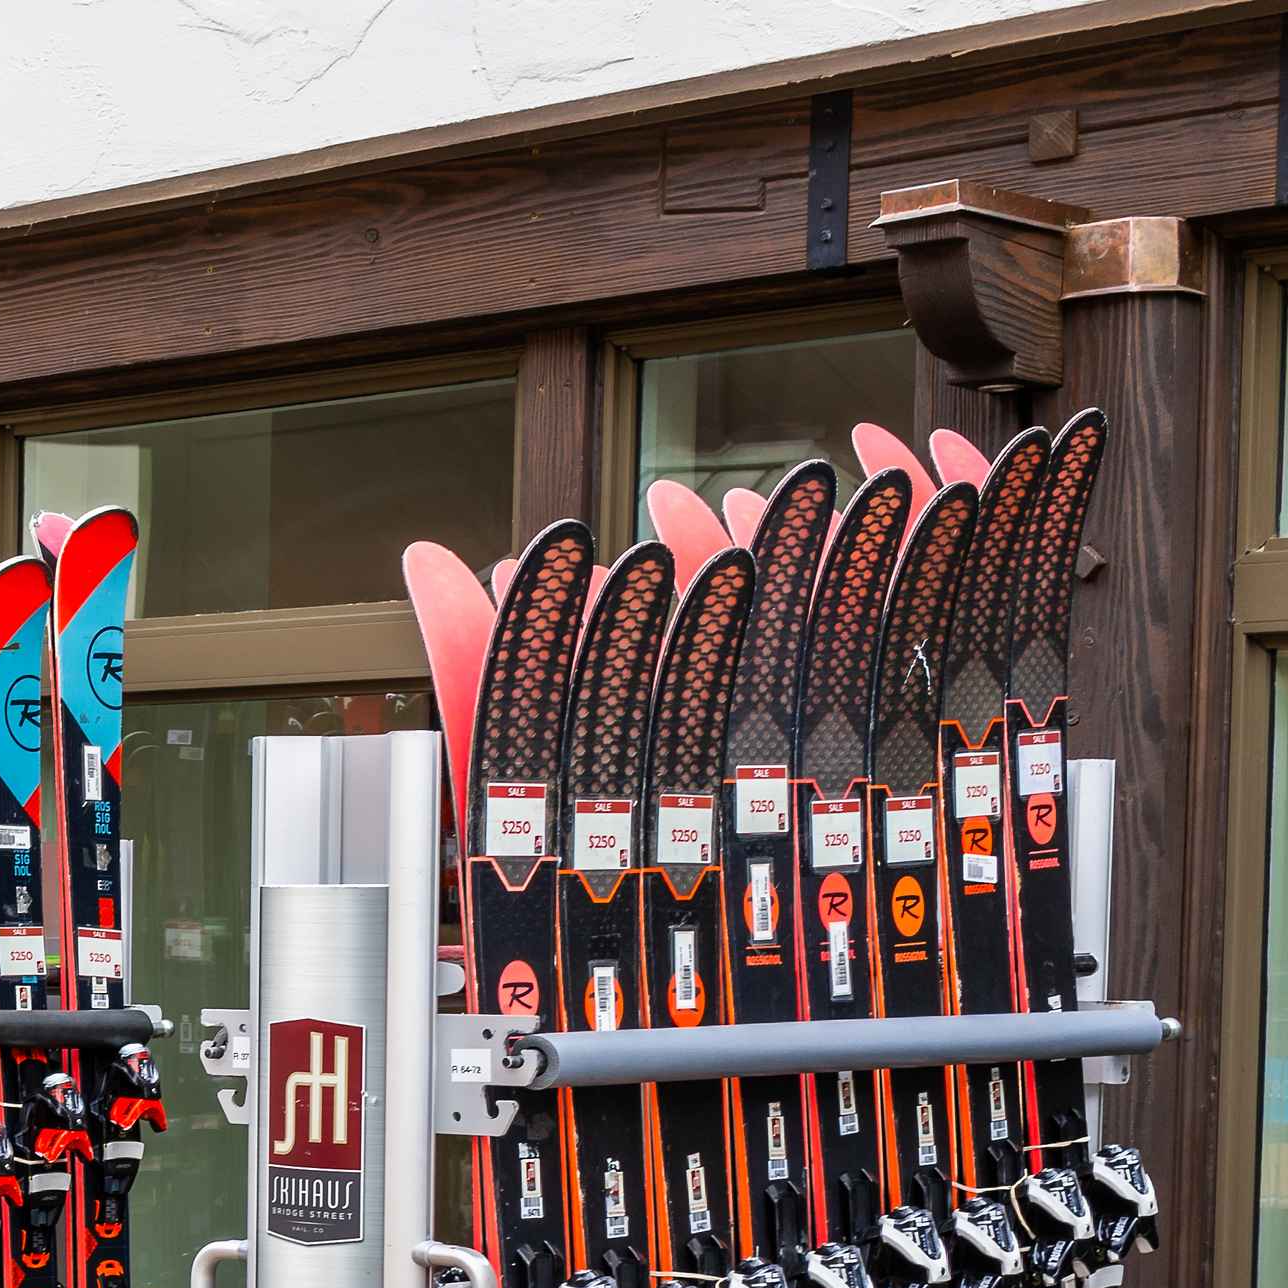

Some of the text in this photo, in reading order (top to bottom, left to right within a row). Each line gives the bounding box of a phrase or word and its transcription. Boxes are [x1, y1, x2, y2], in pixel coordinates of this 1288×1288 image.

[1032, 735, 1046, 744] SALE
[969, 757, 985, 765] SALE
[753, 769, 769, 778] SALE
[1030, 763, 1052, 776] $250
[507, 787, 527, 797] SALE
[966, 785, 988, 798] $250
[94, 800, 112, 812] ROS
[594, 803, 613, 813] SALE
[677, 798, 695, 807] SALE
[749, 799, 775, 813] $250
[828, 804, 844, 812] SALE
[901, 800, 917, 809] SALE
[95, 812, 111, 823] SIG
[1029, 804, 1053, 828] R
[94, 823, 112, 835] NOL
[501, 820, 531, 835] $250
[588, 835, 617, 849] $250
[671, 829, 698, 844] $250
[823, 833, 849, 847] $250
[898, 829, 922, 843] $250
[964, 828, 989, 852] R
[14, 854, 31, 865] SIG
[14, 865, 32, 877] NOL
[822, 891, 849, 917] R
[895, 894, 921, 919] R
[10, 951, 33, 961] $250
[88, 952, 112, 964] $250
[502, 981, 534, 1010] R
[271, 1175, 353, 1210] SKIHAUS
[271, 1206, 353, 1221] BRIDGE STREET
